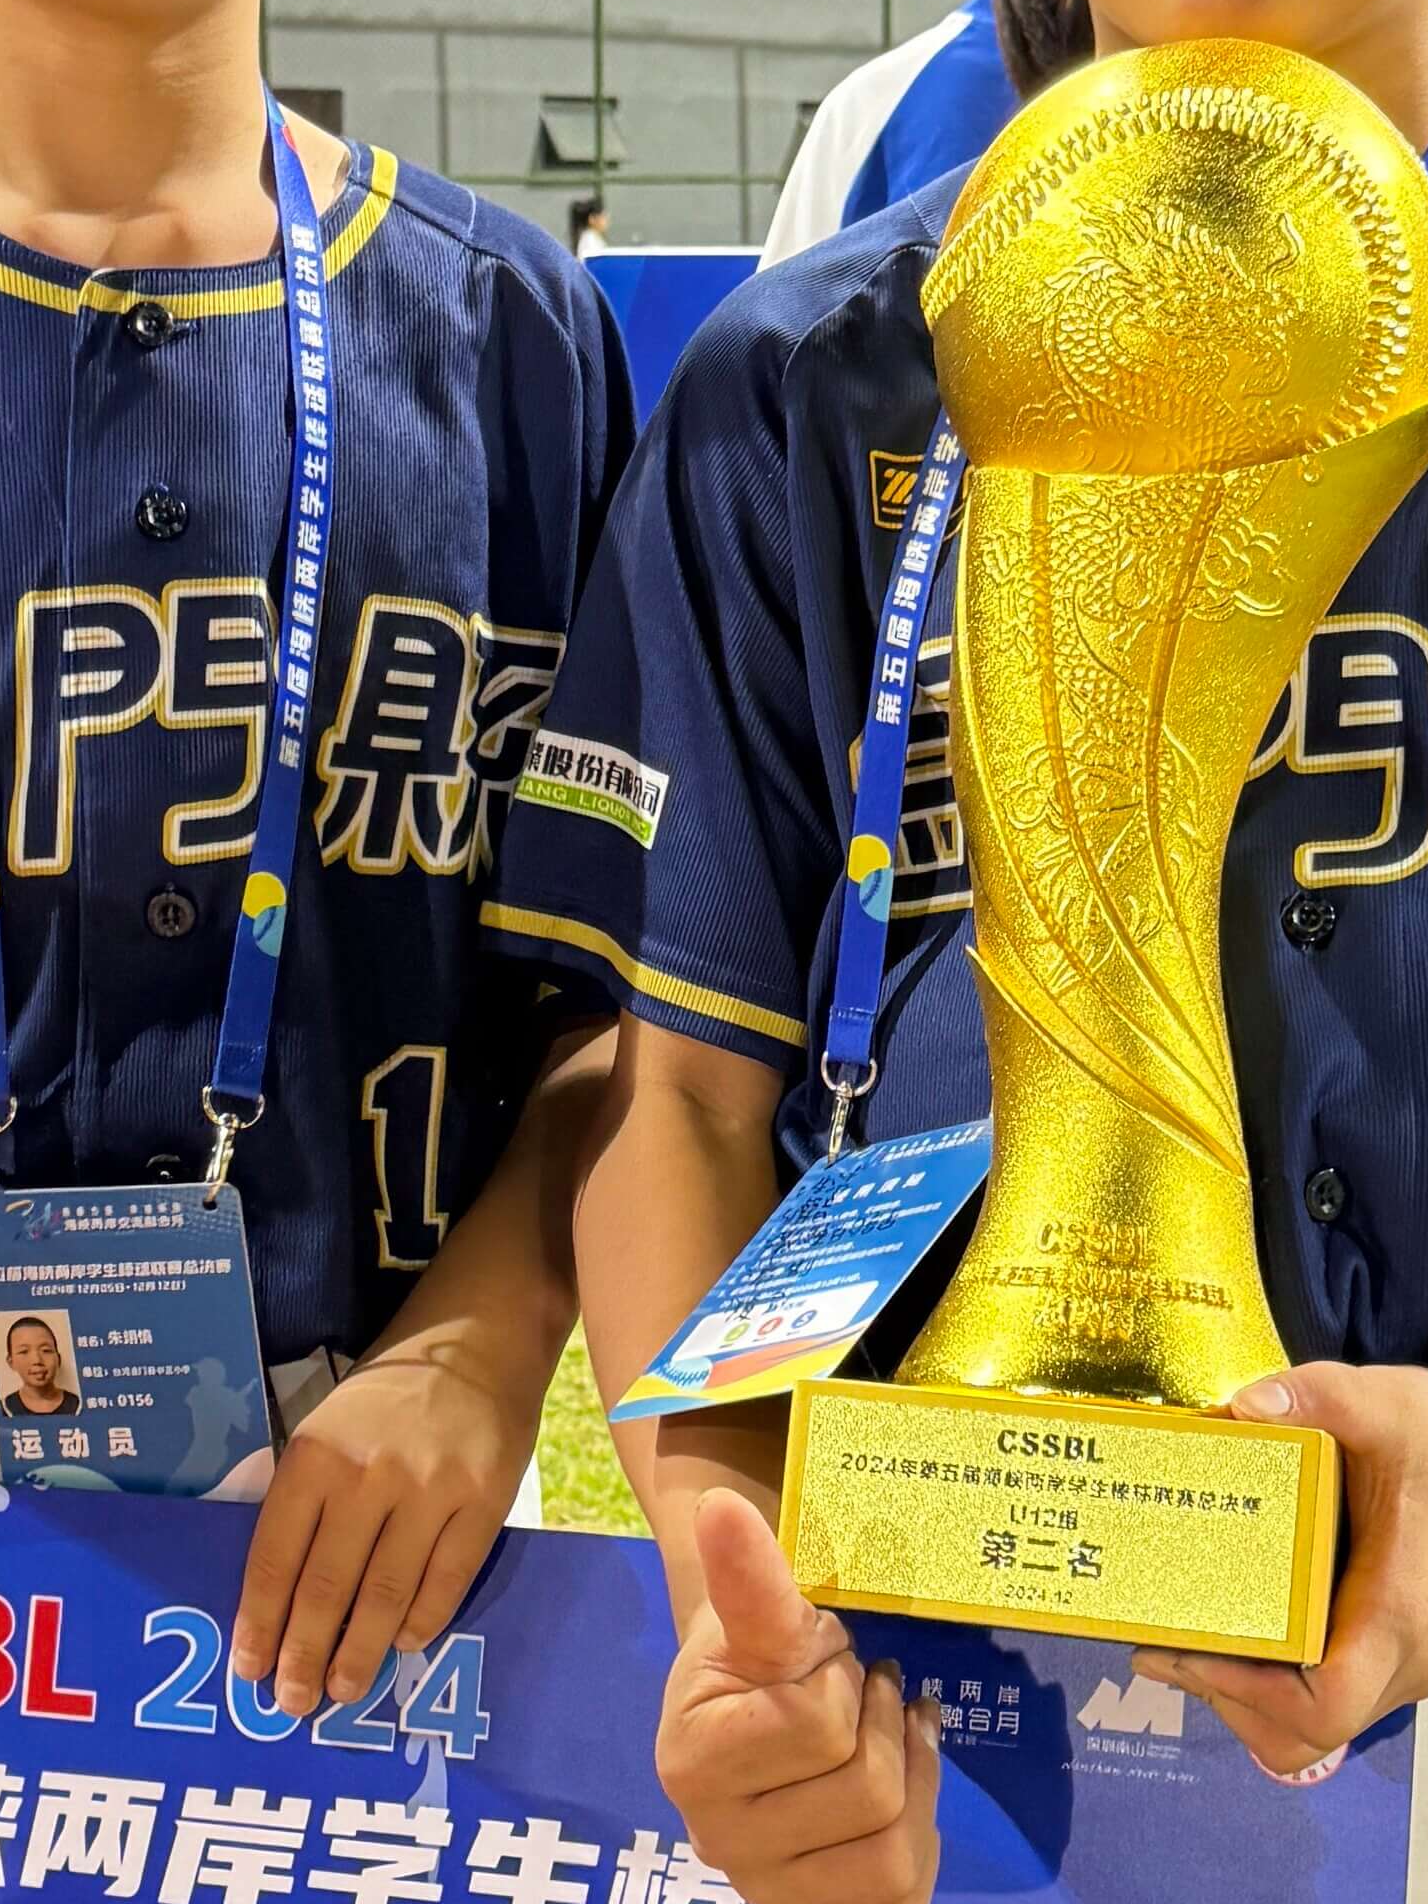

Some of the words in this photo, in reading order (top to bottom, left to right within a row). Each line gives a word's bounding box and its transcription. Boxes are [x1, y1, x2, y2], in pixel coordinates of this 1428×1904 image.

[278, 223, 329, 769] 第五届海峡两岸学生棒球联赛总决赛
[874, 414, 959, 727] 第五届海峡两岸学
[11, 1426, 138, 1461] 运动员
[996, 1428, 1104, 1464] CSSBL
[1009, 1503, 1079, 1530] U12组
[979, 1527, 1103, 1580] 第二名
[901, 1674, 1021, 1706] 峡两岸
